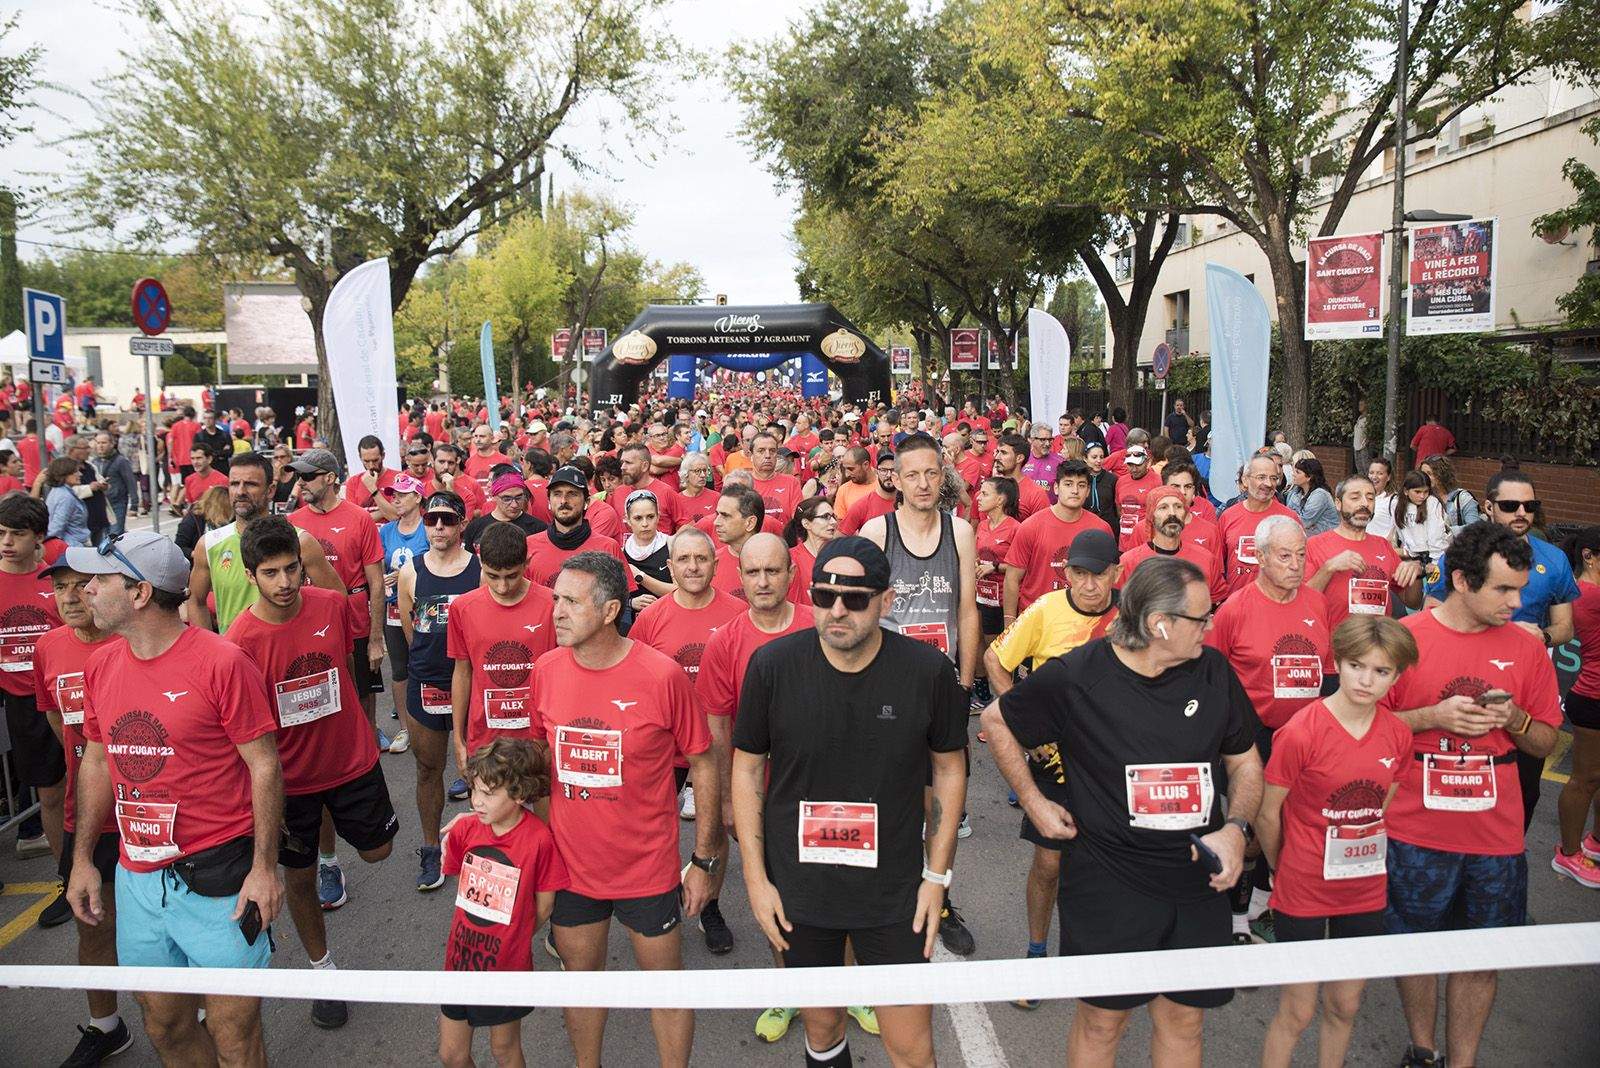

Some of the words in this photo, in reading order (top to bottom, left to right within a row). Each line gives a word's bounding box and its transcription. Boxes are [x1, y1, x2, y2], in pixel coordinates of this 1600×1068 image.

[1424, 259, 1448, 270] VINE
[1449, 259, 1457, 267] A
[1458, 255, 1477, 265] FER
[1422, 272, 1433, 280] EL
[1447, 295, 1472, 303] CURSA
[36, 299, 58, 352] P
[666, 336, 707, 344] TORRONS
[708, 336, 751, 344] ARTESANS
[754, 335, 811, 343] D'AGRAMUNT
[1287, 670, 1313, 679] JOAN
[291, 688, 323, 703] JESUS
[299, 699, 320, 711] 2435
[500, 701, 525, 710] ALEX
[107, 744, 128, 754] SANT
[570, 748, 609, 761] ALBERT
[1440, 775, 1483, 785] GERARD
[1149, 785, 1190, 800] LLUIS
[1321, 808, 1347, 820] SANT
[129, 820, 161, 835] NACHO
[819, 828, 861, 841] 1132
[1344, 843, 1378, 858] 3103
[468, 872, 513, 897] BRUNO
[454, 920, 502, 955] CAMPUS
